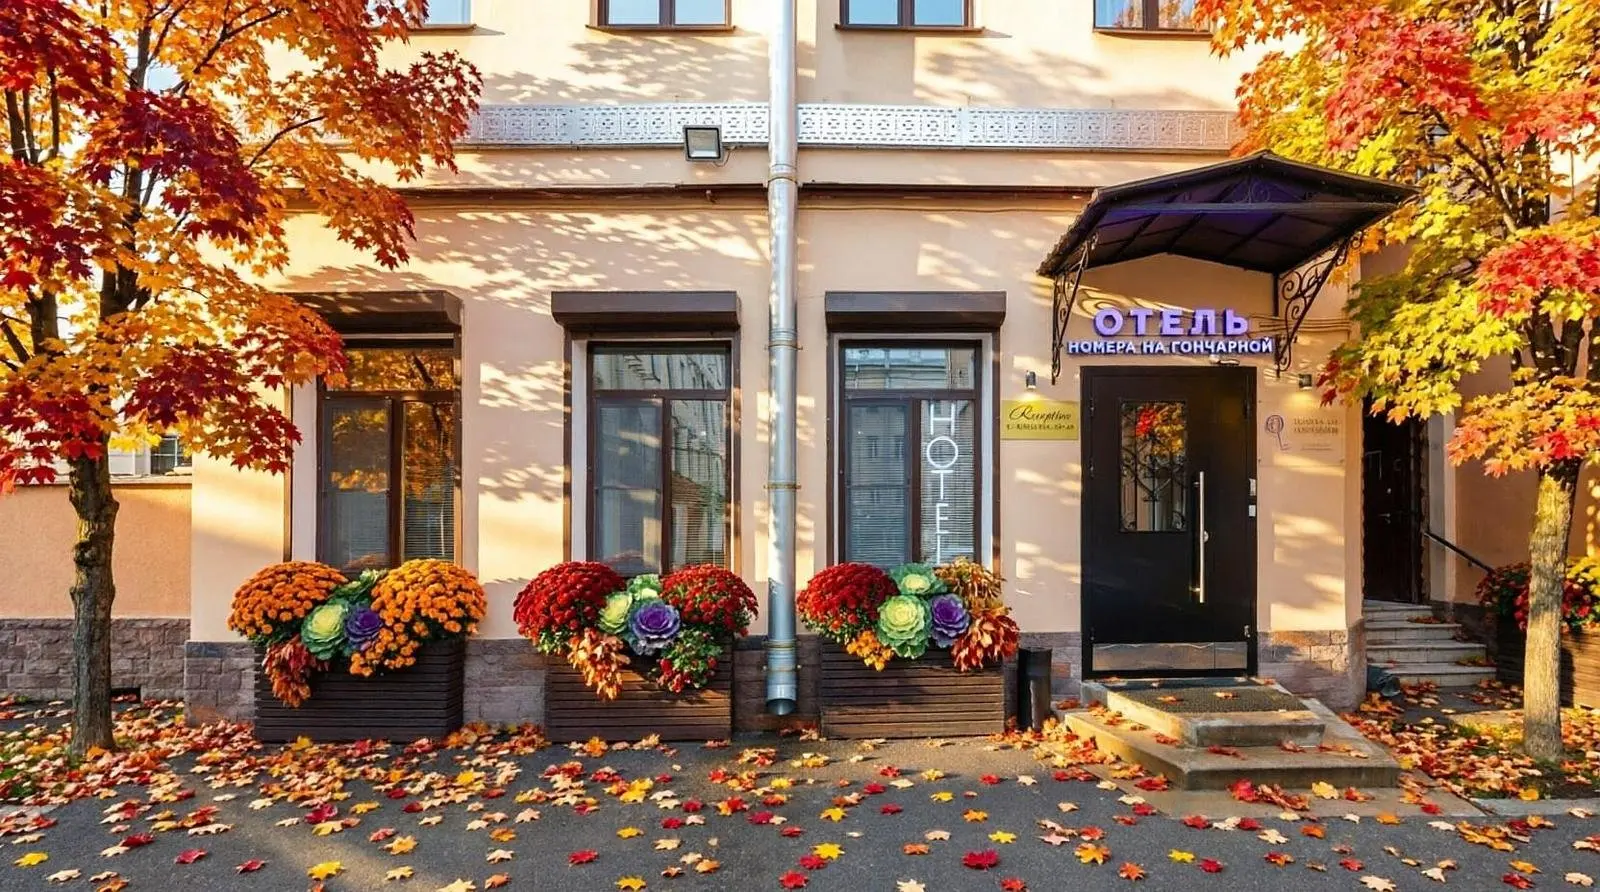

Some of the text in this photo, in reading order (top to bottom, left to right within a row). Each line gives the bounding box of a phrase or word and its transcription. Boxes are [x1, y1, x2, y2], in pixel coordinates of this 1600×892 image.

[1094, 308, 1249, 336] ОТЕЛЬ
[1068, 337, 1274, 355] НОМЕРА НА ГОНЧАРНОЙ
